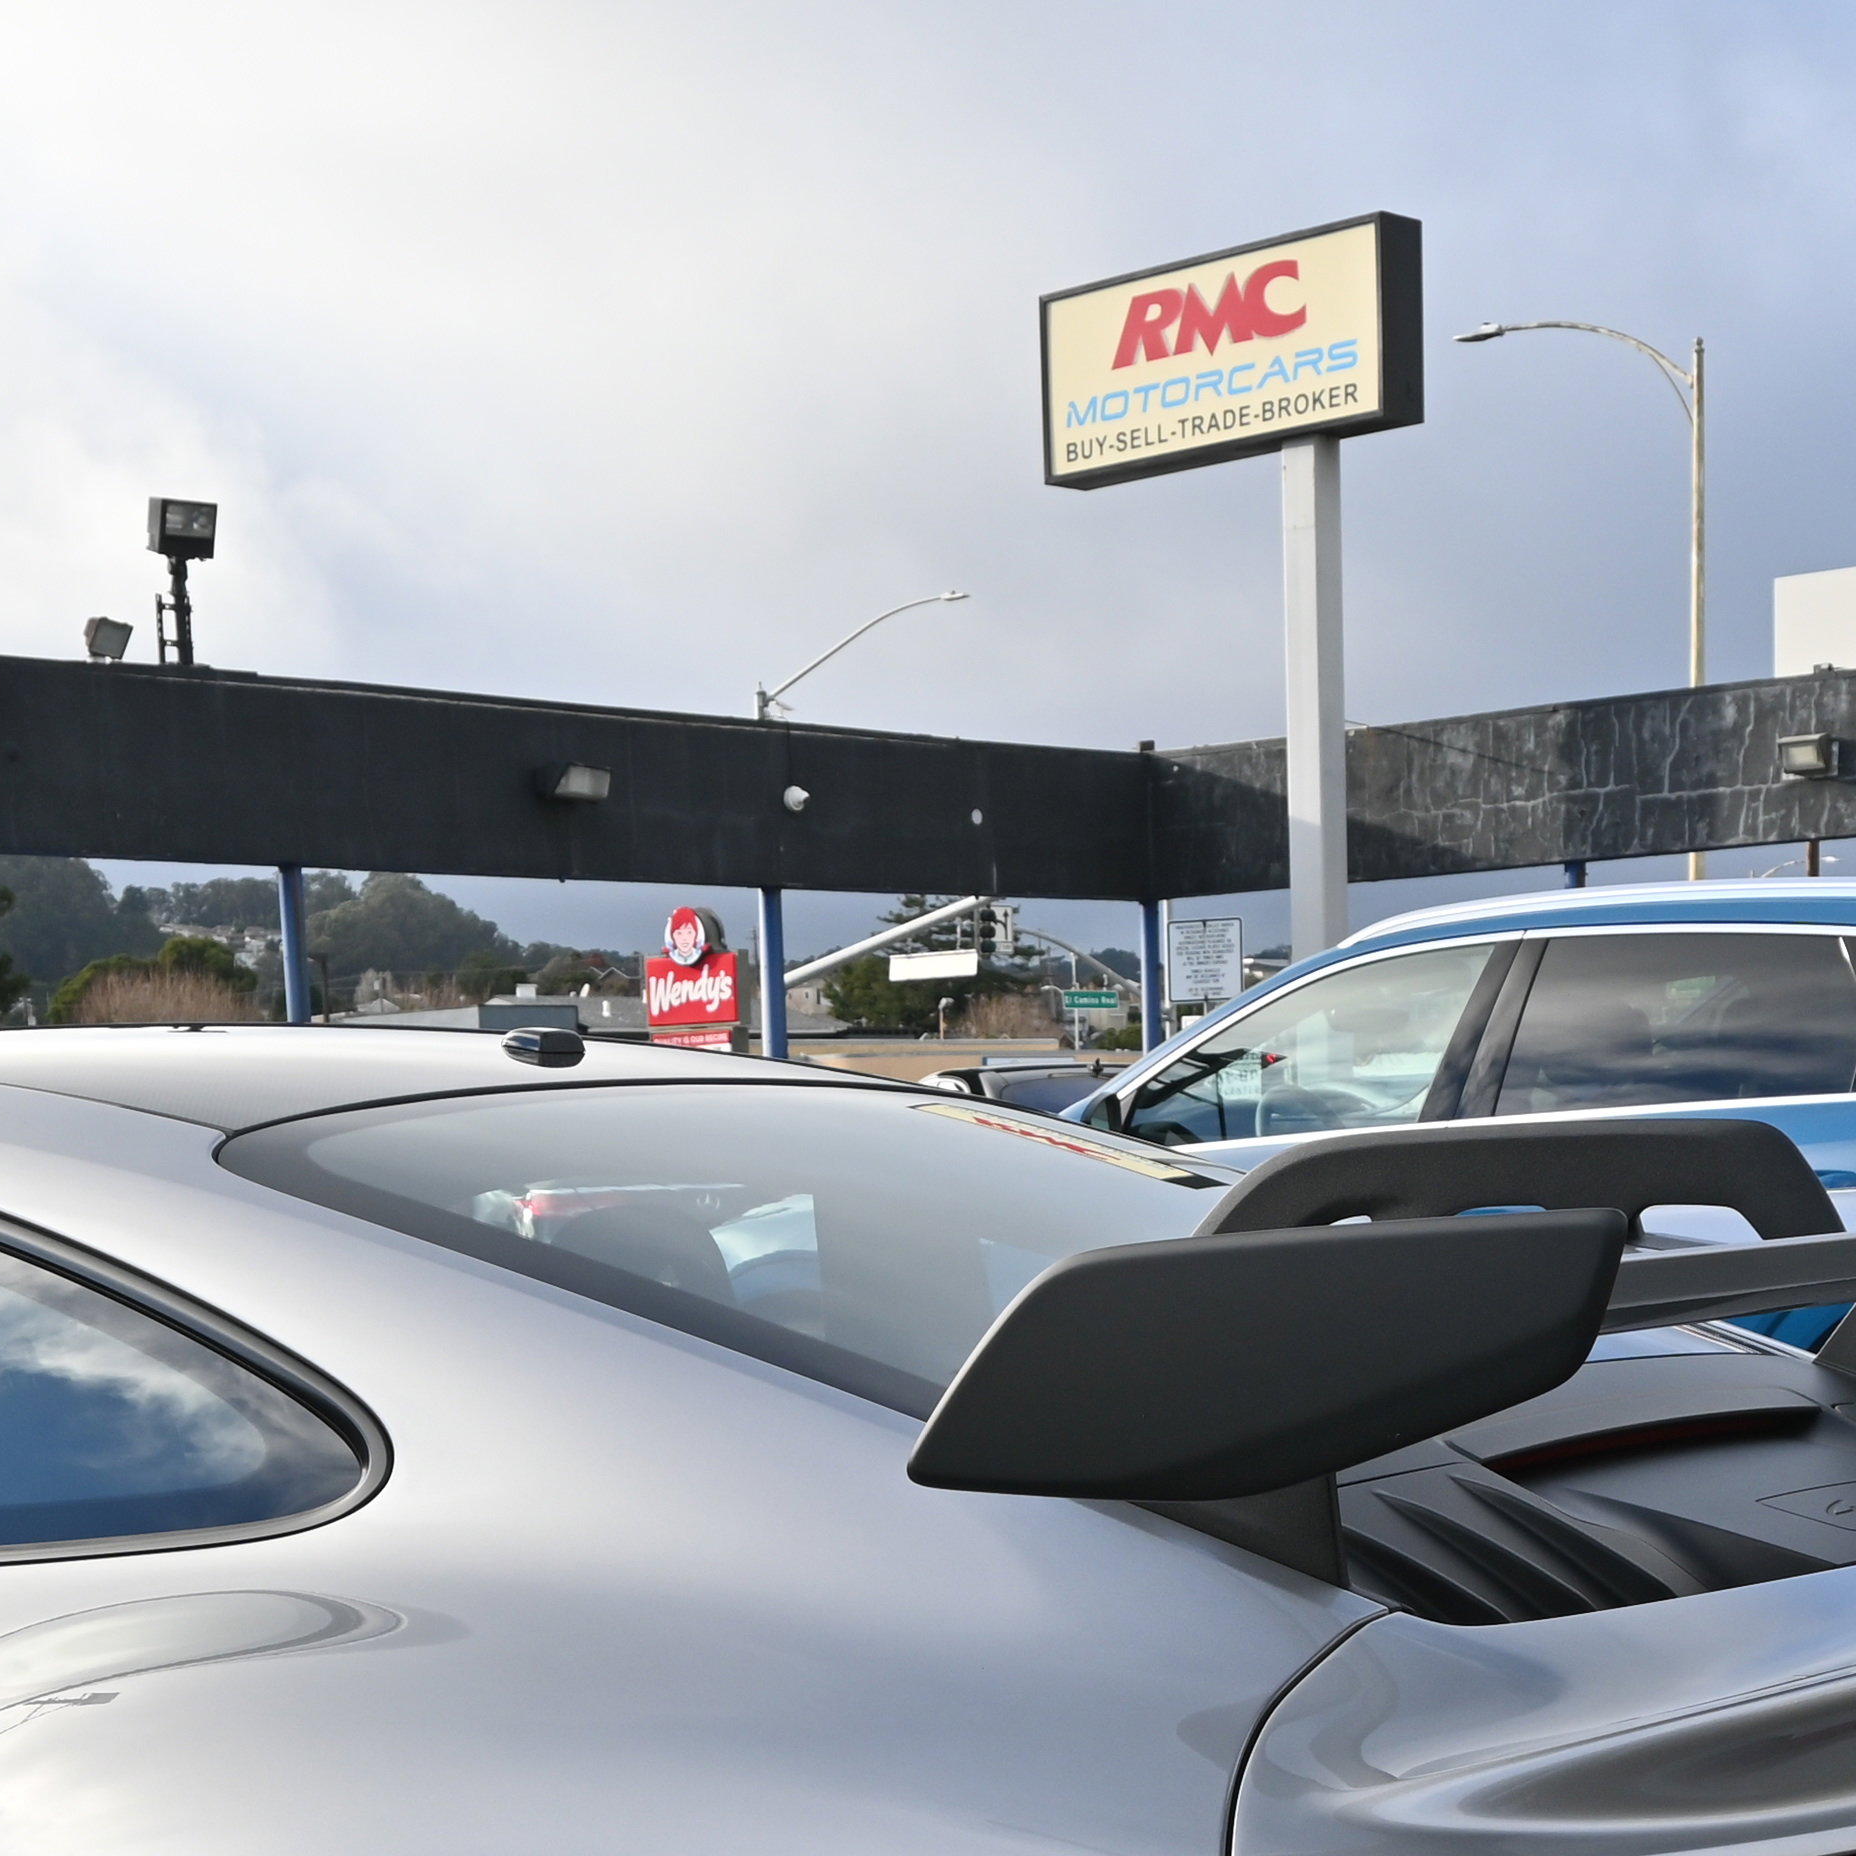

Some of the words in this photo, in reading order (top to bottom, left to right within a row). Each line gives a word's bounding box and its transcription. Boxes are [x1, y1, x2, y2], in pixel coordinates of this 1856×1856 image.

[1112, 259, 1307, 370] RMC
[1066, 339, 1359, 428] MOTORCARS
[1066, 383, 1359, 463] BUY-SELL-TRADE-BROKER
[649, 964, 733, 1016] Wendy's
